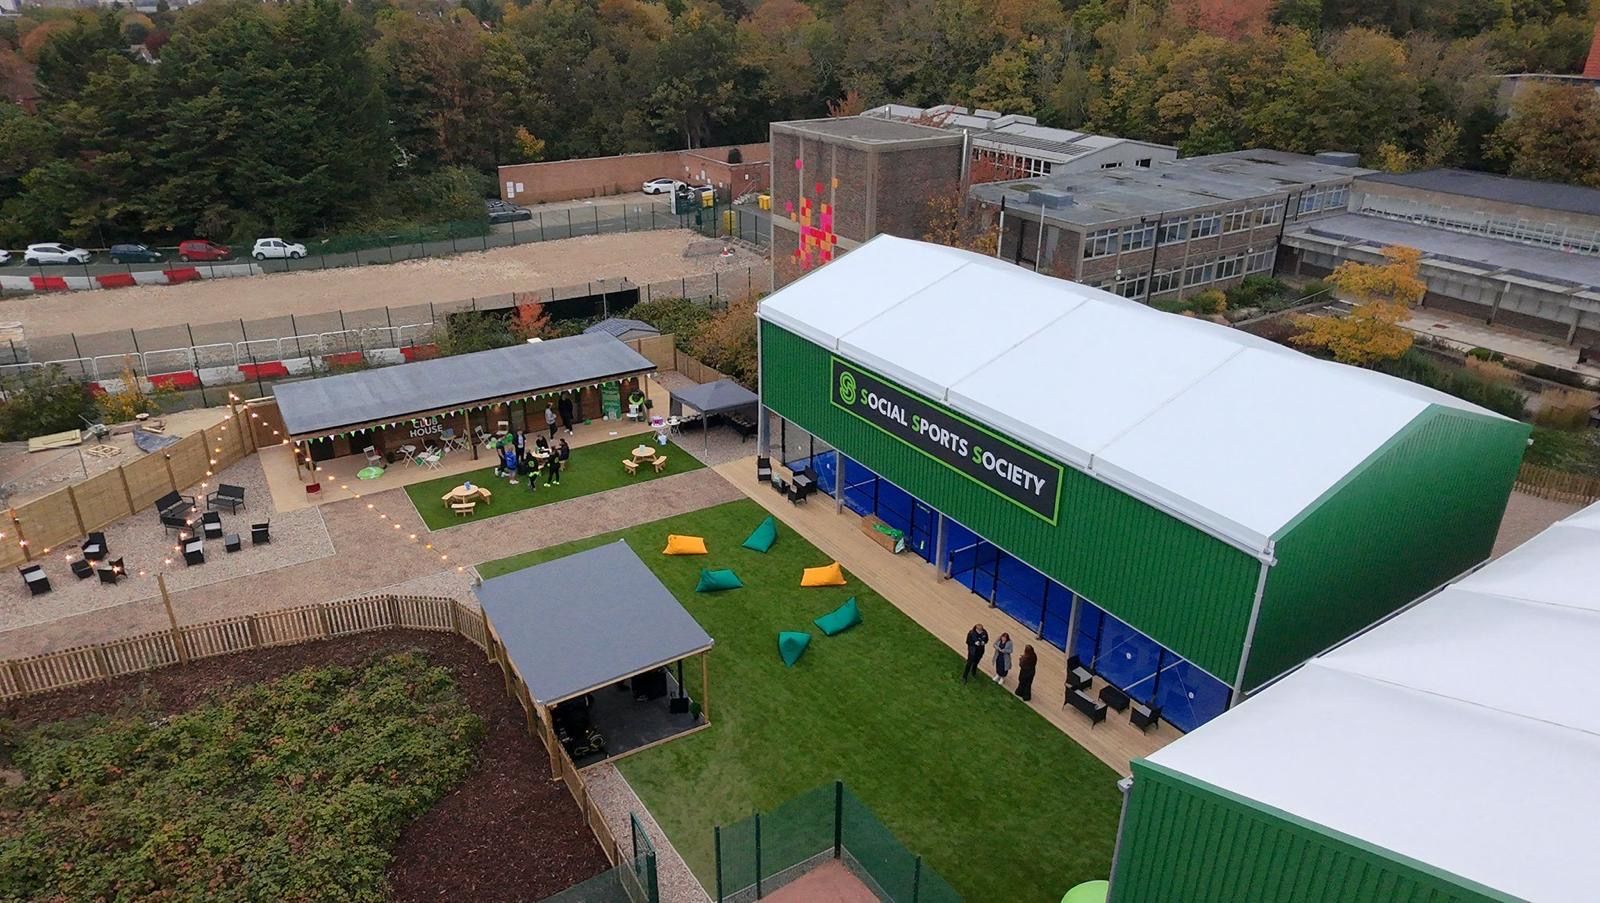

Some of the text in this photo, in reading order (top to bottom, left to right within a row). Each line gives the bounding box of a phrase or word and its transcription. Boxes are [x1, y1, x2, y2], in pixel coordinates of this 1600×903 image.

[412, 418, 438, 429] CLUB
[409, 424, 443, 438] HOUSE
[860, 388, 1046, 496] SOCIAL SPORTS SOCIETY
